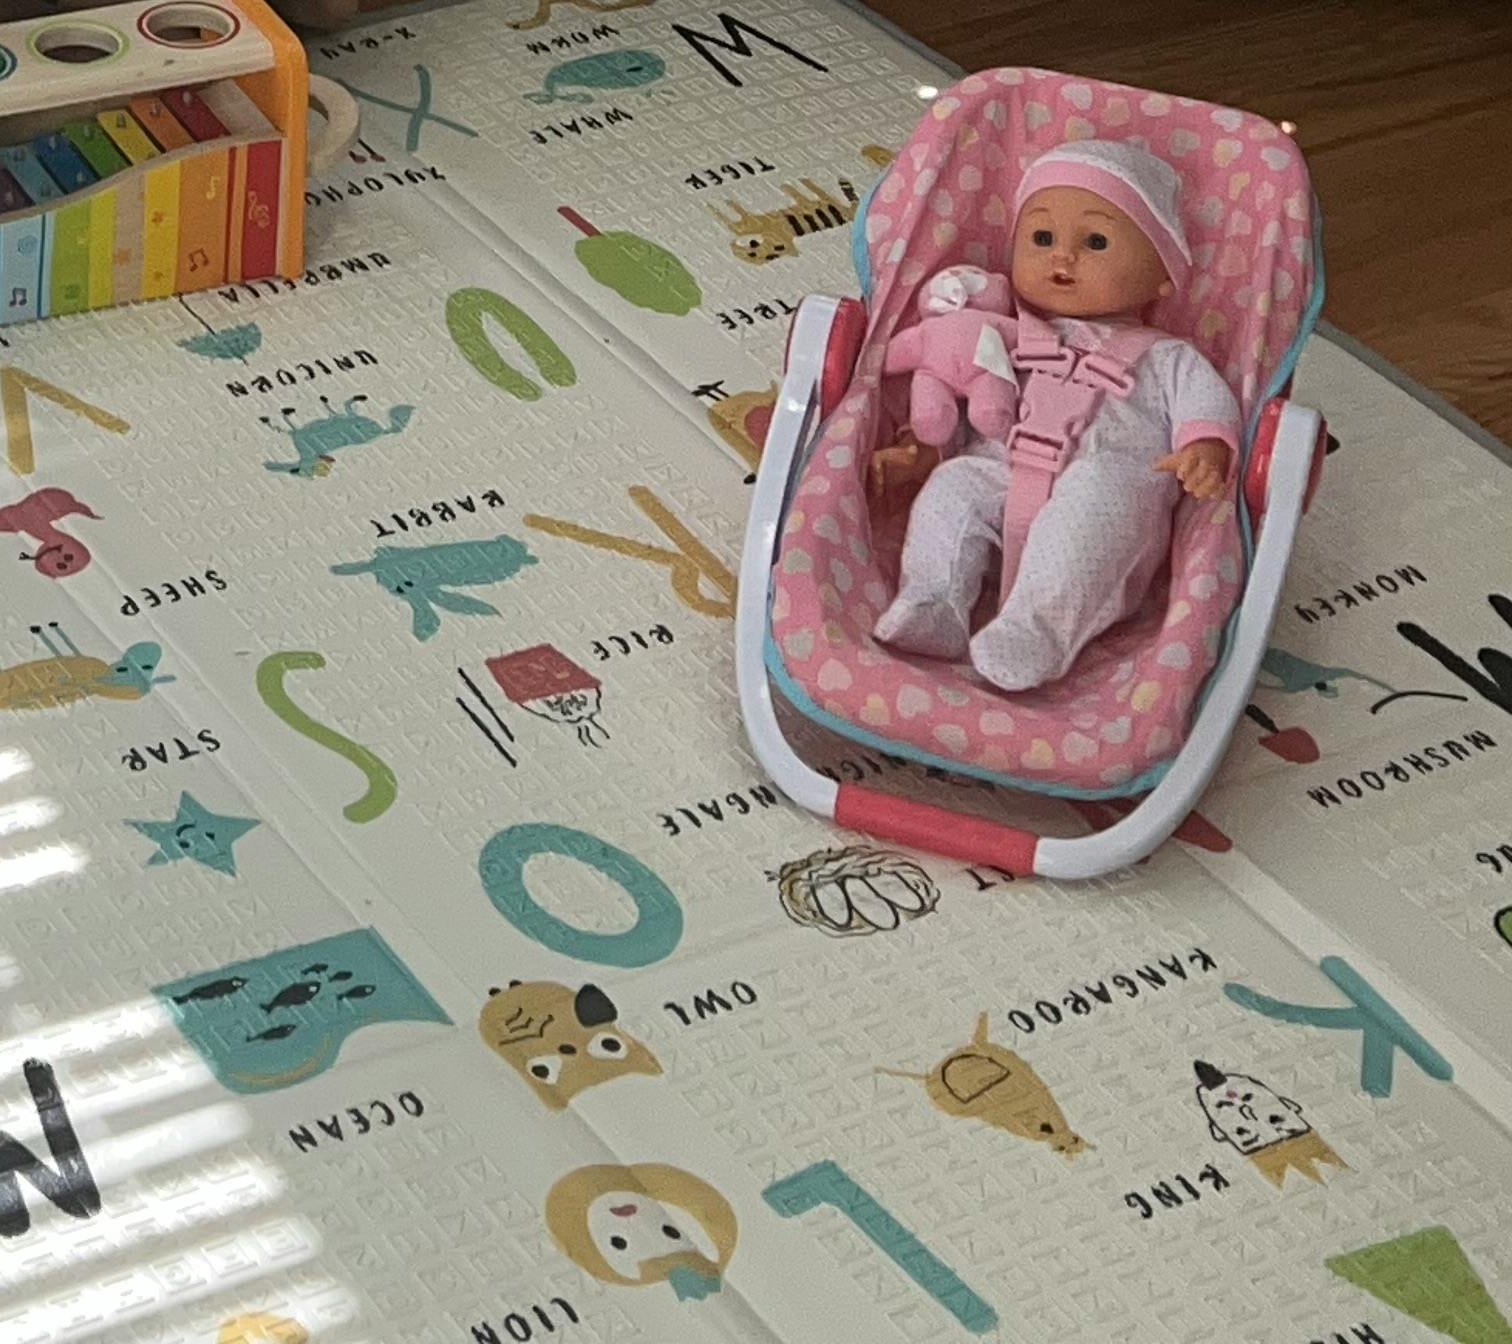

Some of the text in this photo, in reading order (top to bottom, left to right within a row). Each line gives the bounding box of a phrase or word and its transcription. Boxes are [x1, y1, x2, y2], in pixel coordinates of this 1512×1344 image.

[320, 25, 416, 60] X-RAY
[525, 23, 621, 56] WORM
[672, 11, 829, 89] W
[334, 63, 480, 153] X
[530, 106, 634, 146] WHALE
[304, 165, 447, 207] XYLOPHO
[685, 154, 777, 192] TIGER
[715, 297, 799, 331] TREE
[445, 285, 577, 404] U
[226, 348, 379, 399] UNICORN
[0, 365, 133, 475] V
[371, 488, 506, 540] RABBIT
[119, 568, 228, 618] SHEEP
[1296, 563, 1428, 625] MONKEY
[592, 622, 676, 662] RICE
[120, 728, 222, 772] STAR
[255, 650, 399, 825] S
[1306, 728, 1497, 811] MUSHROOM
[477, 820, 685, 970] O
[662, 979, 758, 1027] OWL
[1008, 946, 1218, 1034] KANGAROO
[1222, 953, 1454, 1099] K
[288, 1090, 424, 1154] OCEAN
[1122, 1162, 1231, 1220] KING
[470, 1296, 581, 1344] LION
